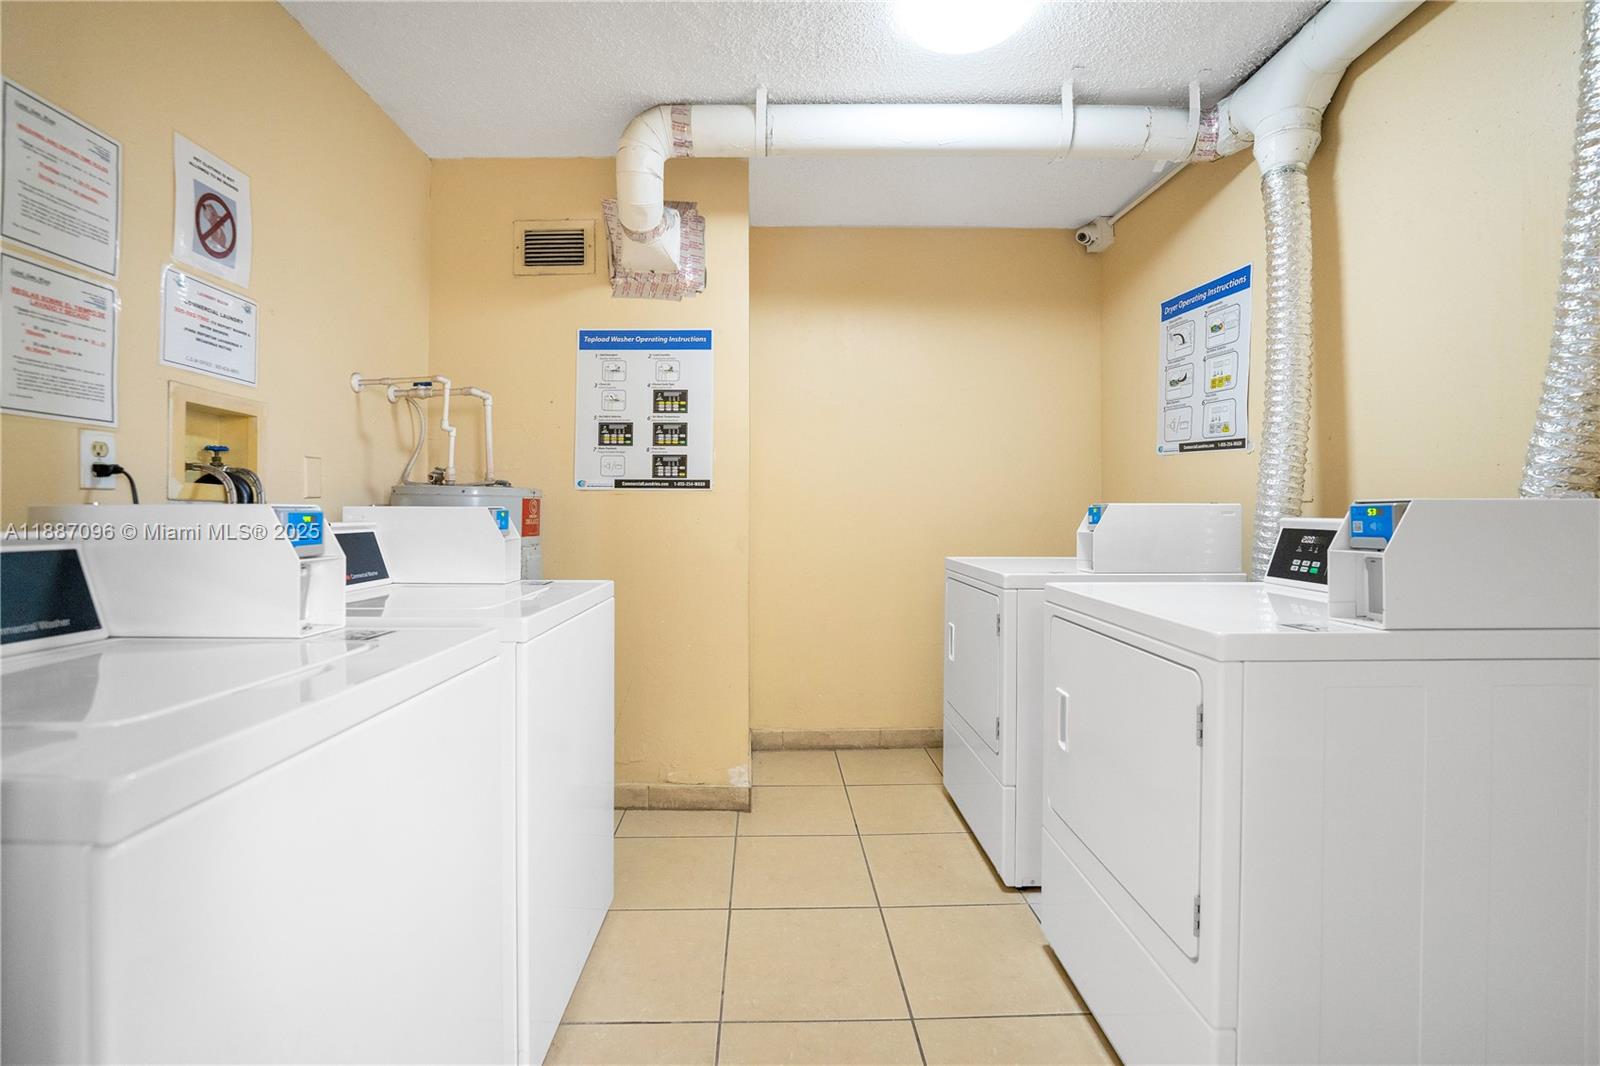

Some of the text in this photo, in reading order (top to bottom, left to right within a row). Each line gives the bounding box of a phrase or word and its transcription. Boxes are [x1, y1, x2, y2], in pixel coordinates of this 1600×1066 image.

[1164, 305, 1179, 315] Dryer
[1179, 292, 1207, 309] Operating
[1208, 275, 1247, 297] Instructions
[584, 335, 707, 344] Topload Washer Operating Instructions
